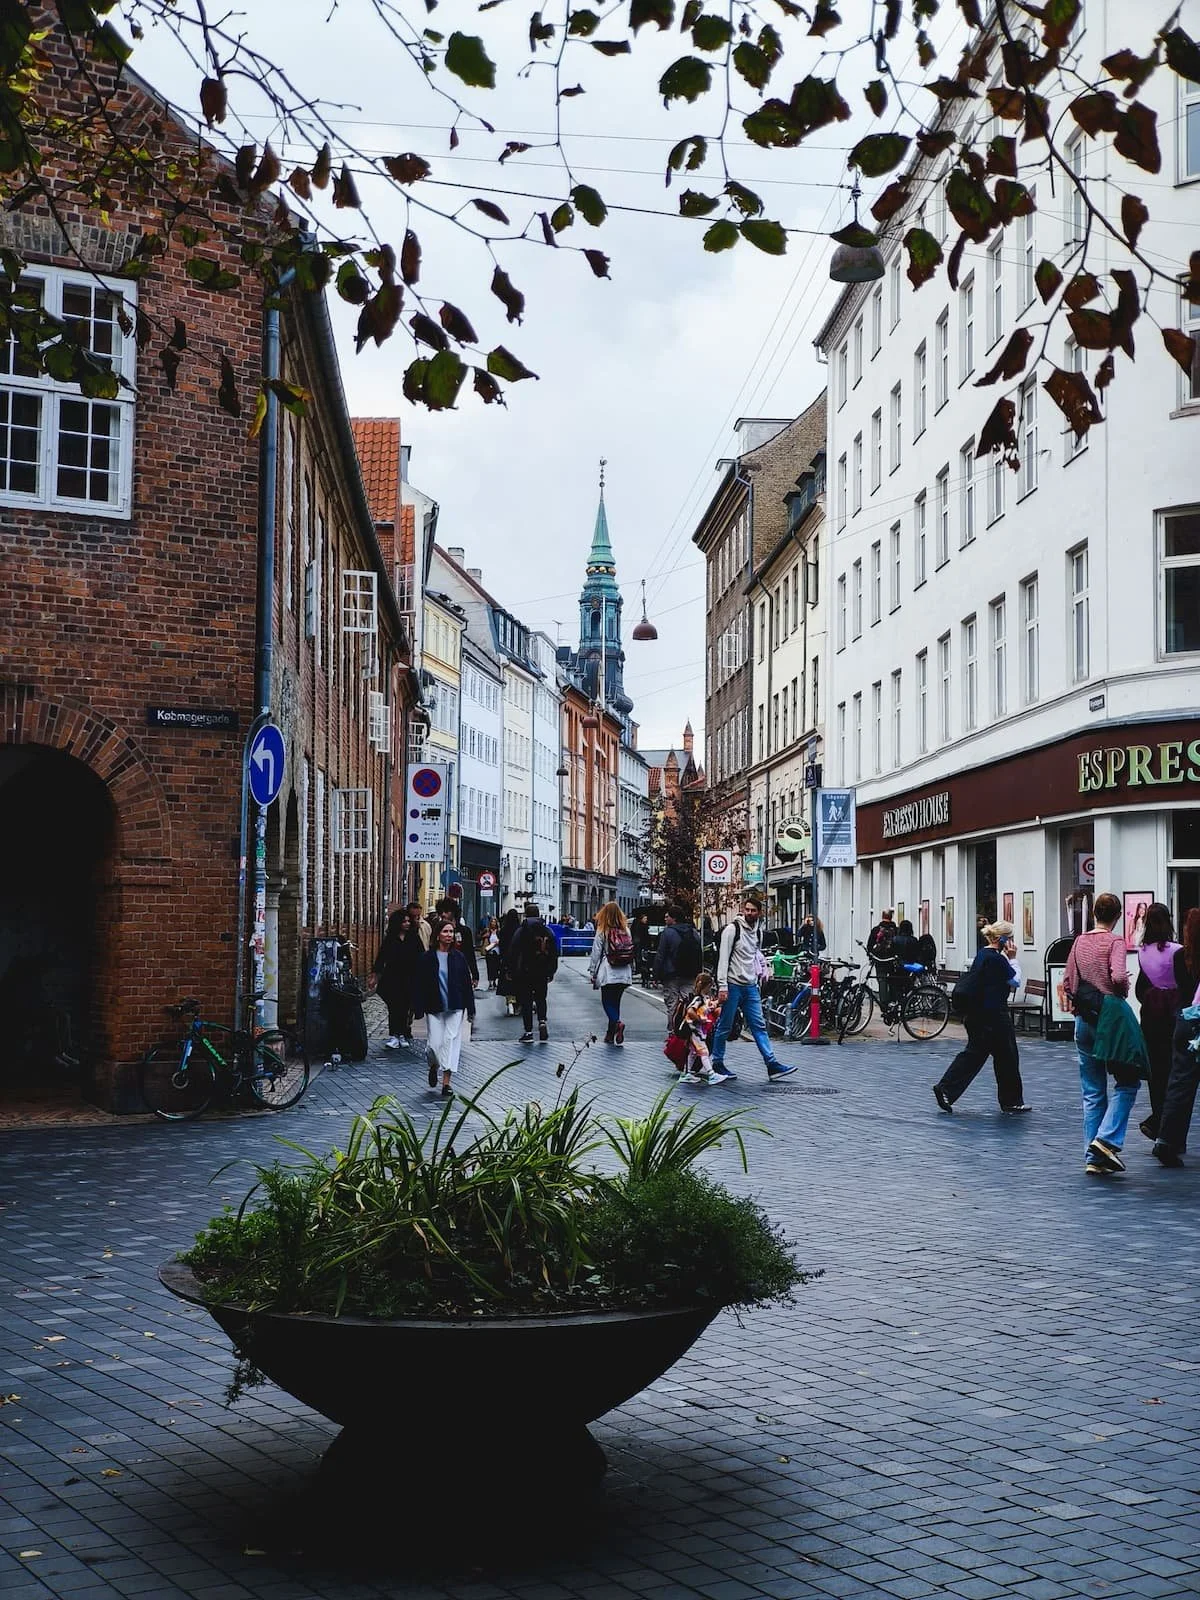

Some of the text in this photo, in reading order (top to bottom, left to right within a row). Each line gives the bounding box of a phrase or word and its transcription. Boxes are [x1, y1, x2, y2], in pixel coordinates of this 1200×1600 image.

[157, 709, 230, 724] Købmagergade
[882, 791, 949, 839] ESPRESSO HOUSE
[778, 816, 811, 833] ESPRESSO
[414, 851, 435, 859] Zone
[826, 856, 848, 864] Zone
[712, 860, 724, 869] 30
[202, 1038, 228, 1066] GIANT
